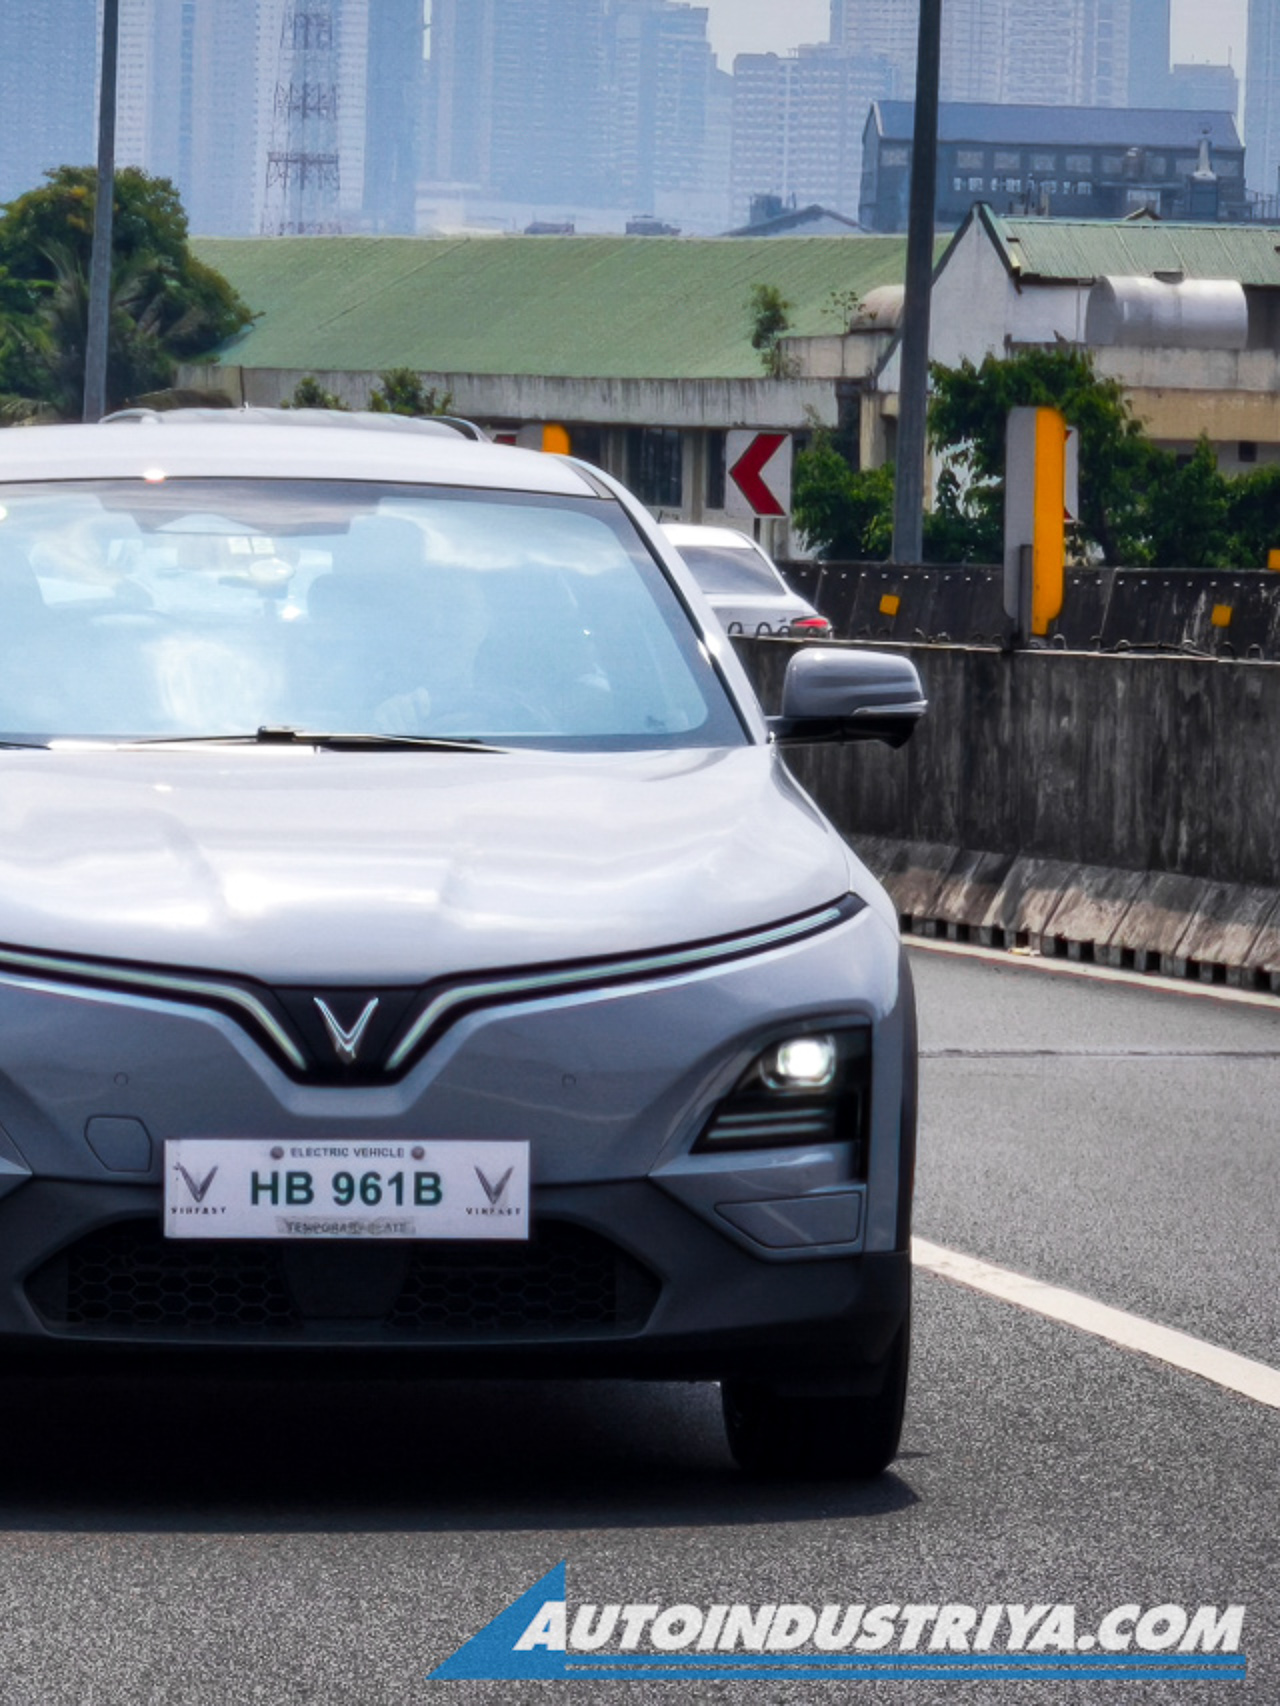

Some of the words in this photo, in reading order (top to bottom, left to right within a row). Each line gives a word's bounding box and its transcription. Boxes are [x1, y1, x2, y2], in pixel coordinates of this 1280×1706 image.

[290, 1147, 349, 1158] ELECTRIC
[353, 1147, 405, 1158] VEHICLE
[250, 1170, 315, 1206] HB
[331, 1170, 443, 1206] 961B
